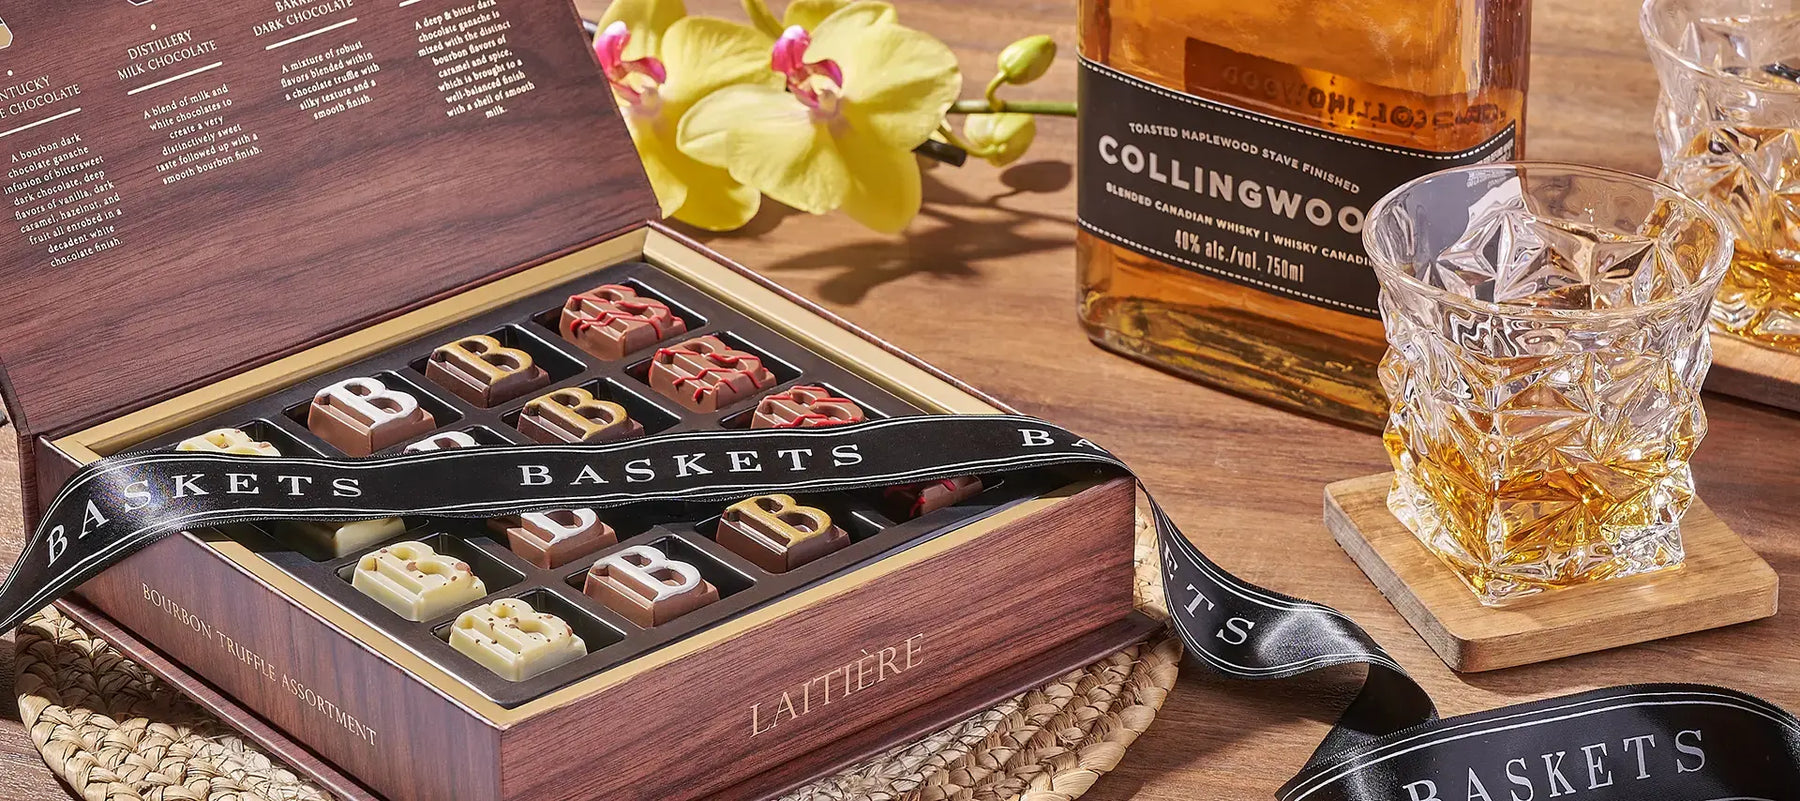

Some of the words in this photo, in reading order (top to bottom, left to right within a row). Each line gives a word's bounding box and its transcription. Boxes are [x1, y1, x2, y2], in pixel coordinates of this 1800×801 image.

[253, 19, 284, 37] DARK
[286, 0, 354, 25] CHOCOLATE
[275, 0, 315, 12] BAR
[415, 21, 422, 30] A
[423, 15, 443, 28] deep
[444, 11, 452, 21] &
[452, 5, 476, 18] bitter
[478, 0, 497, 10] dark
[128, 30, 193, 60] DISTILLERY
[418, 41, 444, 57] mixed
[445, 35, 464, 48] with
[464, 32, 478, 42] the
[480, 21, 511, 37] distinct
[419, 24, 457, 43] chocolate
[459, 13, 491, 32] ganache
[492, 11, 501, 19] is
[117, 63, 146, 81] MILK
[148, 40, 218, 70] CHOCOLATE
[282, 65, 289, 74] A
[290, 55, 324, 71] mixture
[325, 49, 335, 60] of
[336, 41, 364, 56] robust
[432, 49, 468, 66] bourbon
[469, 42, 497, 54] flavors
[498, 34, 507, 45] of
[438, 61, 471, 78] caramel
[472, 55, 488, 67] and
[281, 74, 310, 88] flavors
[311, 60, 345, 78] blended
[346, 52, 374, 67] within
[293, 79, 333, 99] chocolate
[334, 70, 360, 85] truffle
[361, 63, 380, 76] with
[438, 77, 464, 92] which
[464, 75, 473, 84] is
[473, 64, 506, 81] brought
[517, 59, 523, 67] a
[446, 78, 502, 104] well-balanced
[502, 70, 526, 85] finish
[9, 84, 82, 116] CHOCOLATE
[144, 110, 151, 120] A
[152, 101, 178, 117] blend
[179, 96, 188, 107] of
[190, 89, 211, 104] milk
[212, 84, 229, 97] and
[300, 97, 320, 111] silky
[322, 86, 352, 103] texture
[353, 79, 370, 92] and
[370, 79, 377, 87] a
[314, 104, 345, 120] smooth
[346, 94, 373, 109] finish.
[447, 104, 466, 118] with
[474, 95, 494, 109] shell
[495, 91, 504, 102] of
[505, 81, 536, 99] smooth
[485, 105, 508, 119] milk.
[149, 115, 174, 131] white
[176, 102, 221, 123] chocolates
[224, 99, 233, 107] to
[169, 124, 196, 140] create
[204, 116, 224, 129] very
[11, 154, 19, 163] A
[20, 142, 59, 160] bourbon
[60, 133, 82, 147] dark
[156, 159, 178, 173] taste
[179, 145, 217, 165] followed
[218, 144, 230, 155] up
[231, 134, 251, 147] with
[162, 132, 216, 156] distinctively
[218, 124, 242, 138] sweet
[4, 177, 42, 195] infusion
[44, 171, 54, 181] of
[54, 156, 104, 178] bittersweet
[8, 159, 51, 178] chocolate
[53, 146, 89, 166] ganache
[163, 166, 196, 185] smooth
[197, 152, 234, 173] bourbon
[235, 145, 263, 161] finish.
[1129, 122, 1178, 139] TOASTED
[1182, 129, 1259, 156] MAPLEWOOD
[1262, 148, 1300, 170] STAVE
[1302, 163, 1361, 195] FINISHED
[14, 193, 35, 206] dark
[37, 179, 82, 199] chocolate,
[84, 170, 105, 183] deep
[15, 205, 45, 220] flavors
[48, 199, 57, 210] of
[58, 190, 92, 206] vanilla,
[94, 181, 115, 194] dark
[1099, 135, 1364, 234] COLLINGWOO
[21, 215, 59, 234] caramel,
[60, 201, 102, 220] hazelnut,
[104, 193, 121, 206] and
[29, 232, 51, 245] fruit
[53, 225, 65, 238] all
[67, 213, 103, 233] enrobed
[105, 210, 114, 220] in
[116, 208, 122, 216] a
[1106, 182, 1152, 207] BLENDED
[1155, 201, 1213, 226] CANADIAN
[1216, 219, 1260, 239] WHISKY
[1273, 235, 1318, 255] WHISKY
[1321, 247, 1372, 267] CANADI
[48, 234, 89, 254] decadent
[89, 225, 115, 239] white
[51, 247, 94, 267] chocolate
[95, 237, 123, 252] finish.
[1175, 230, 1201, 253] 40%
[1205, 240, 1261, 271] alc./vol.
[1267, 255, 1304, 283] 750ml
[518, 444, 864, 487] BASKETS
[47, 473, 362, 568] BASKETS
[142, 583, 212, 641] BOURBON
[216, 631, 276, 682] TRUFFLE
[282, 674, 377, 746] ASSORTMENT
[750, 633, 923, 738] LAITIÈRE
